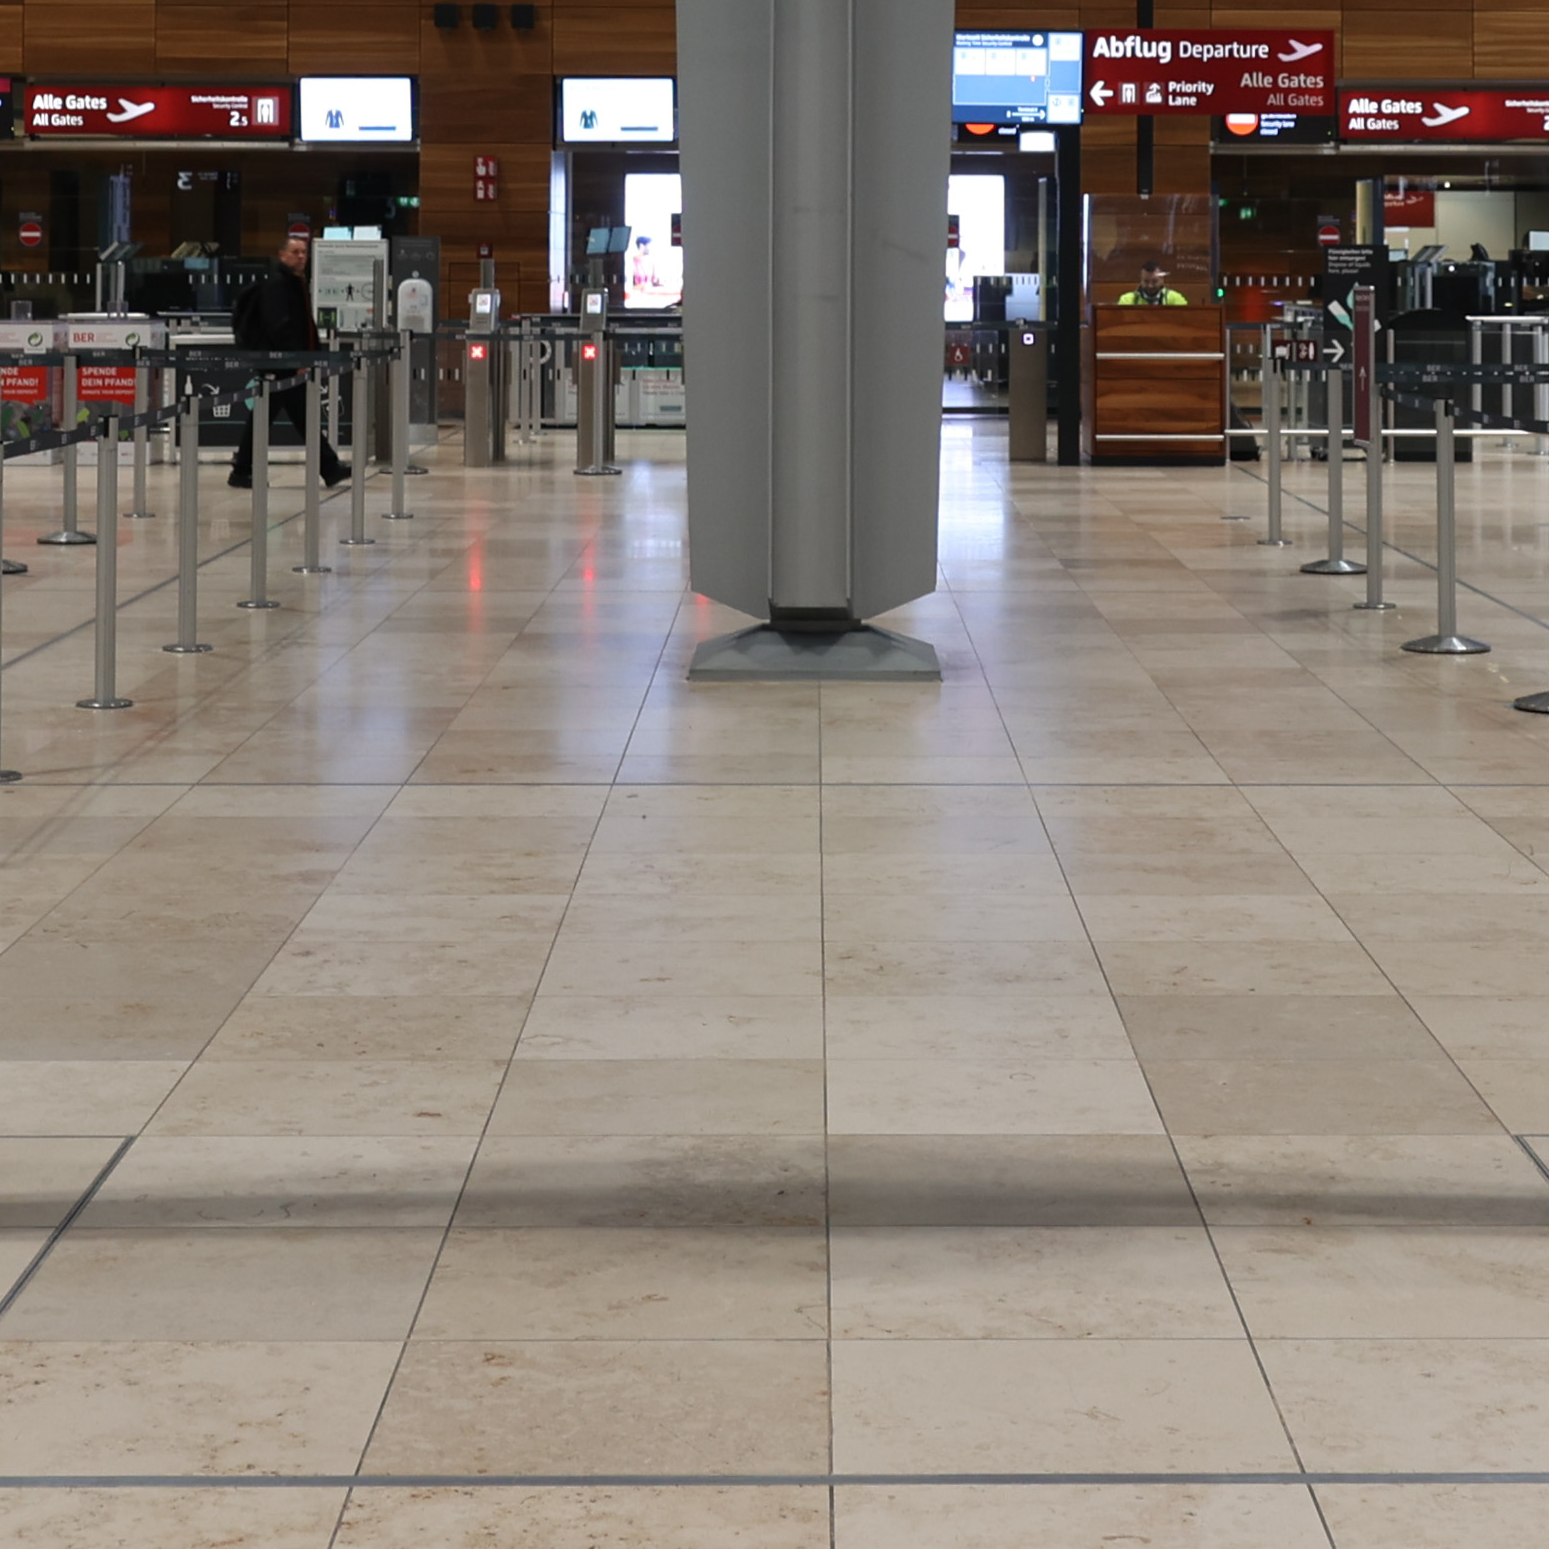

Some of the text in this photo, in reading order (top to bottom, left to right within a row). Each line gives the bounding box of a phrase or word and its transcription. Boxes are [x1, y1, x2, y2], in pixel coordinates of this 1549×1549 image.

[1093, 36, 1269, 64] Abflug Departure
[1240, 73, 1324, 89] Alle Gates
[1167, 81, 1214, 96] Priority
[1167, 94, 1198, 107] Lane
[1267, 93, 1324, 107] All Gates
[73, 333, 95, 343] BER
[82, 367, 117, 376] SPENDE
[82, 378, 136, 387] DEIN PFAND!
